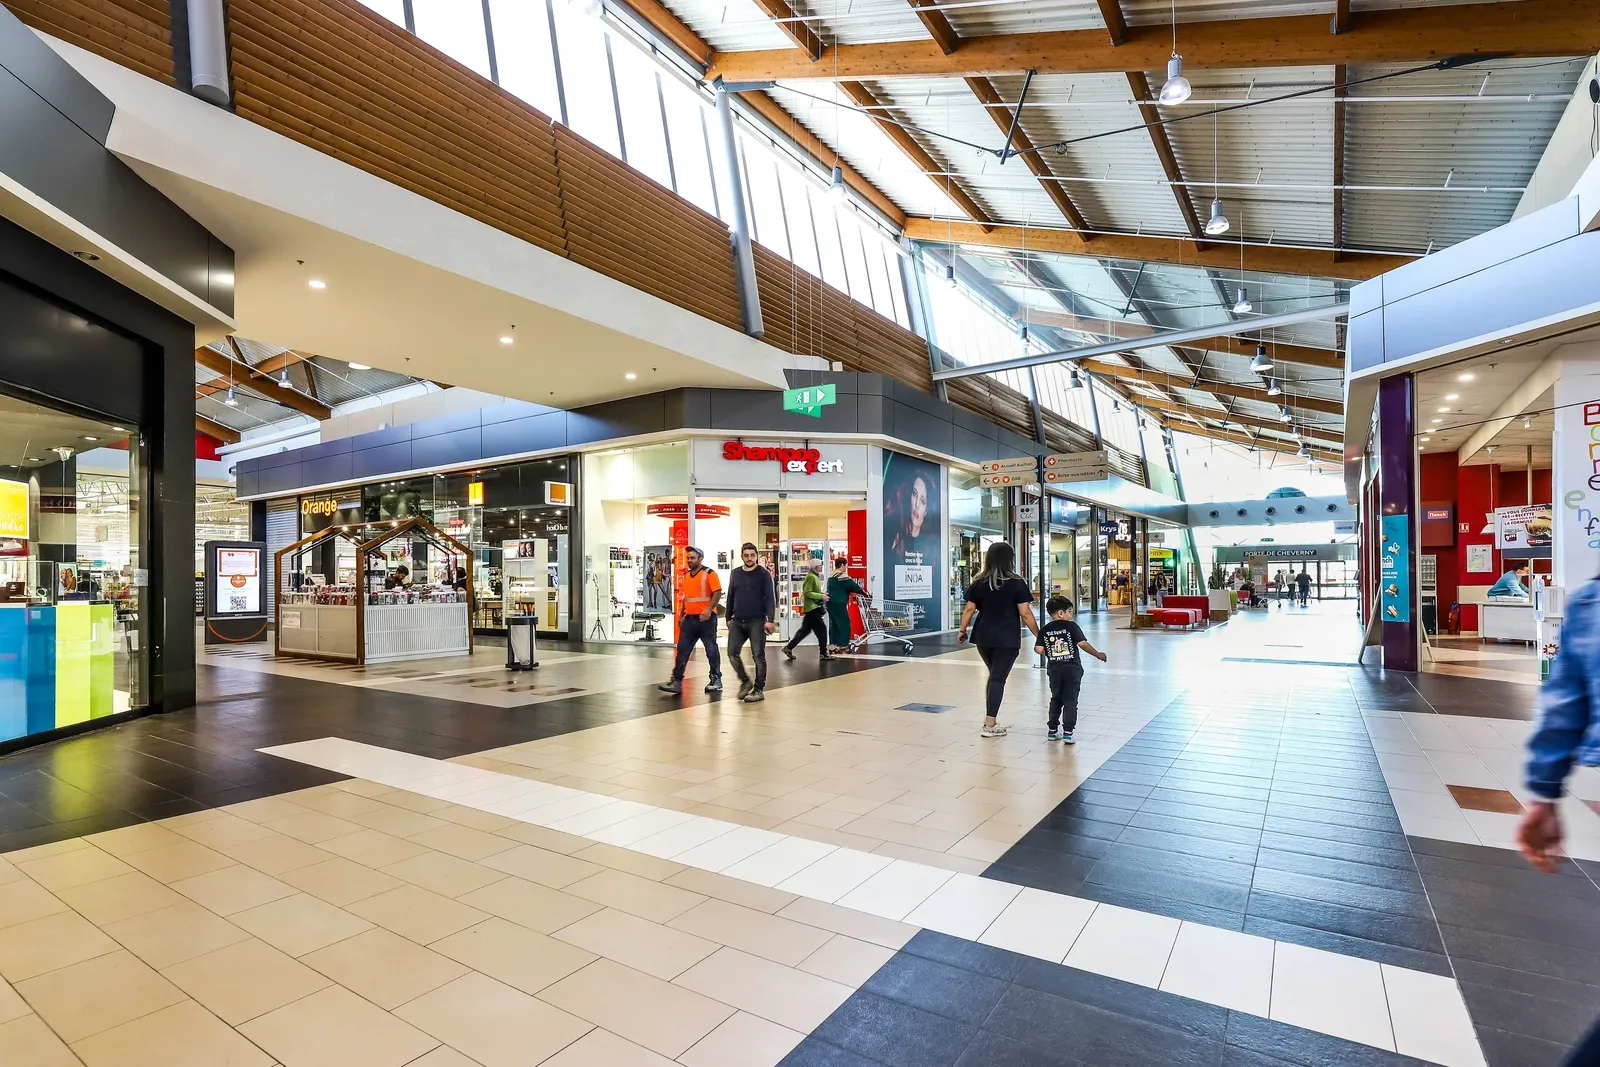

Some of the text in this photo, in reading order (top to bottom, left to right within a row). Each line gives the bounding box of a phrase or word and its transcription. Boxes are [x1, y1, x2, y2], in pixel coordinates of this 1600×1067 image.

[722, 440, 821, 473] Shampoo
[787, 458, 844, 475] expert
[302, 499, 338, 517] Orange
[1100, 525, 1117, 533] Krys
